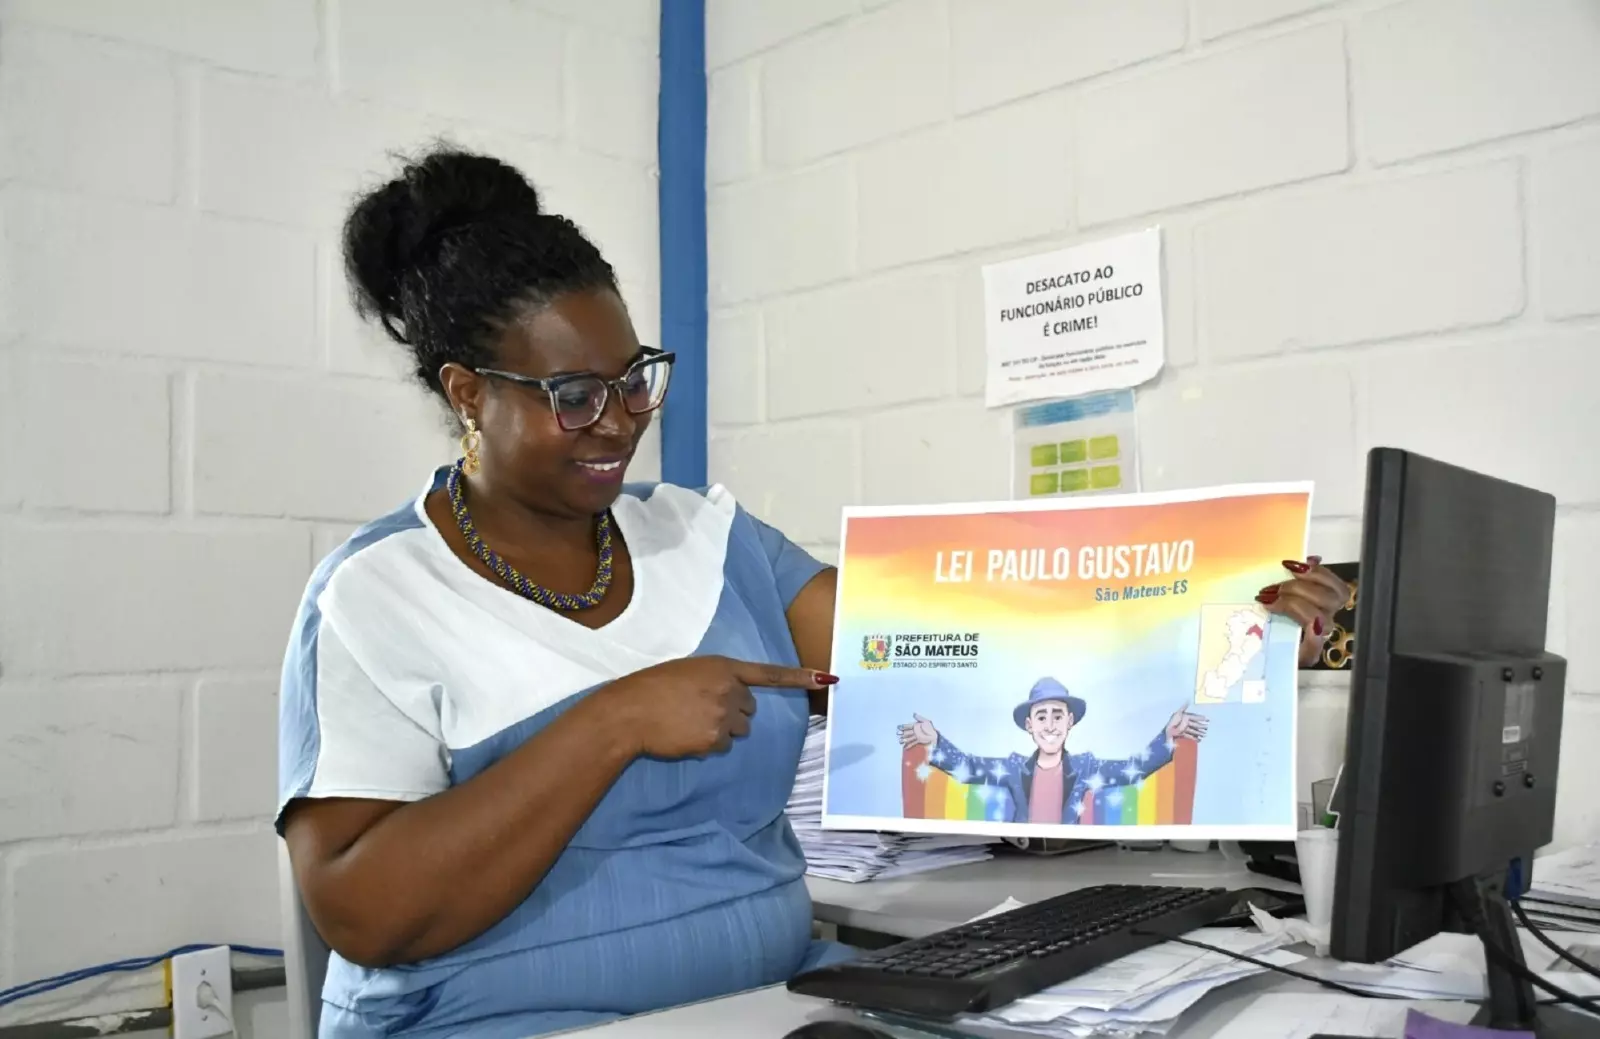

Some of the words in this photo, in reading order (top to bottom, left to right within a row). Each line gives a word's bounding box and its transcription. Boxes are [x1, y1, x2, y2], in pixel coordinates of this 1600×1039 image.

[1026, 270, 1090, 294] DESACATO
[1094, 265, 1114, 280] AO
[1000, 294, 1085, 322] FUNCIONÁRIO
[1088, 282, 1143, 305] PÚBLICO
[1043, 321, 1051, 337] É
[1053, 315, 1098, 335] CRIME!
[934, 550, 974, 583] LEI
[987, 548, 1070, 582] PAULO
[1077, 539, 1195, 580] GUSTAVO
[1095, 587, 1119, 602] São
[1122, 579, 1188, 601] Mateus-ES
[895, 634, 961, 642] PREFEITURA
[964, 633, 979, 642] DE
[895, 643, 921, 656] SÃO
[924, 645, 978, 657] MATEUS
